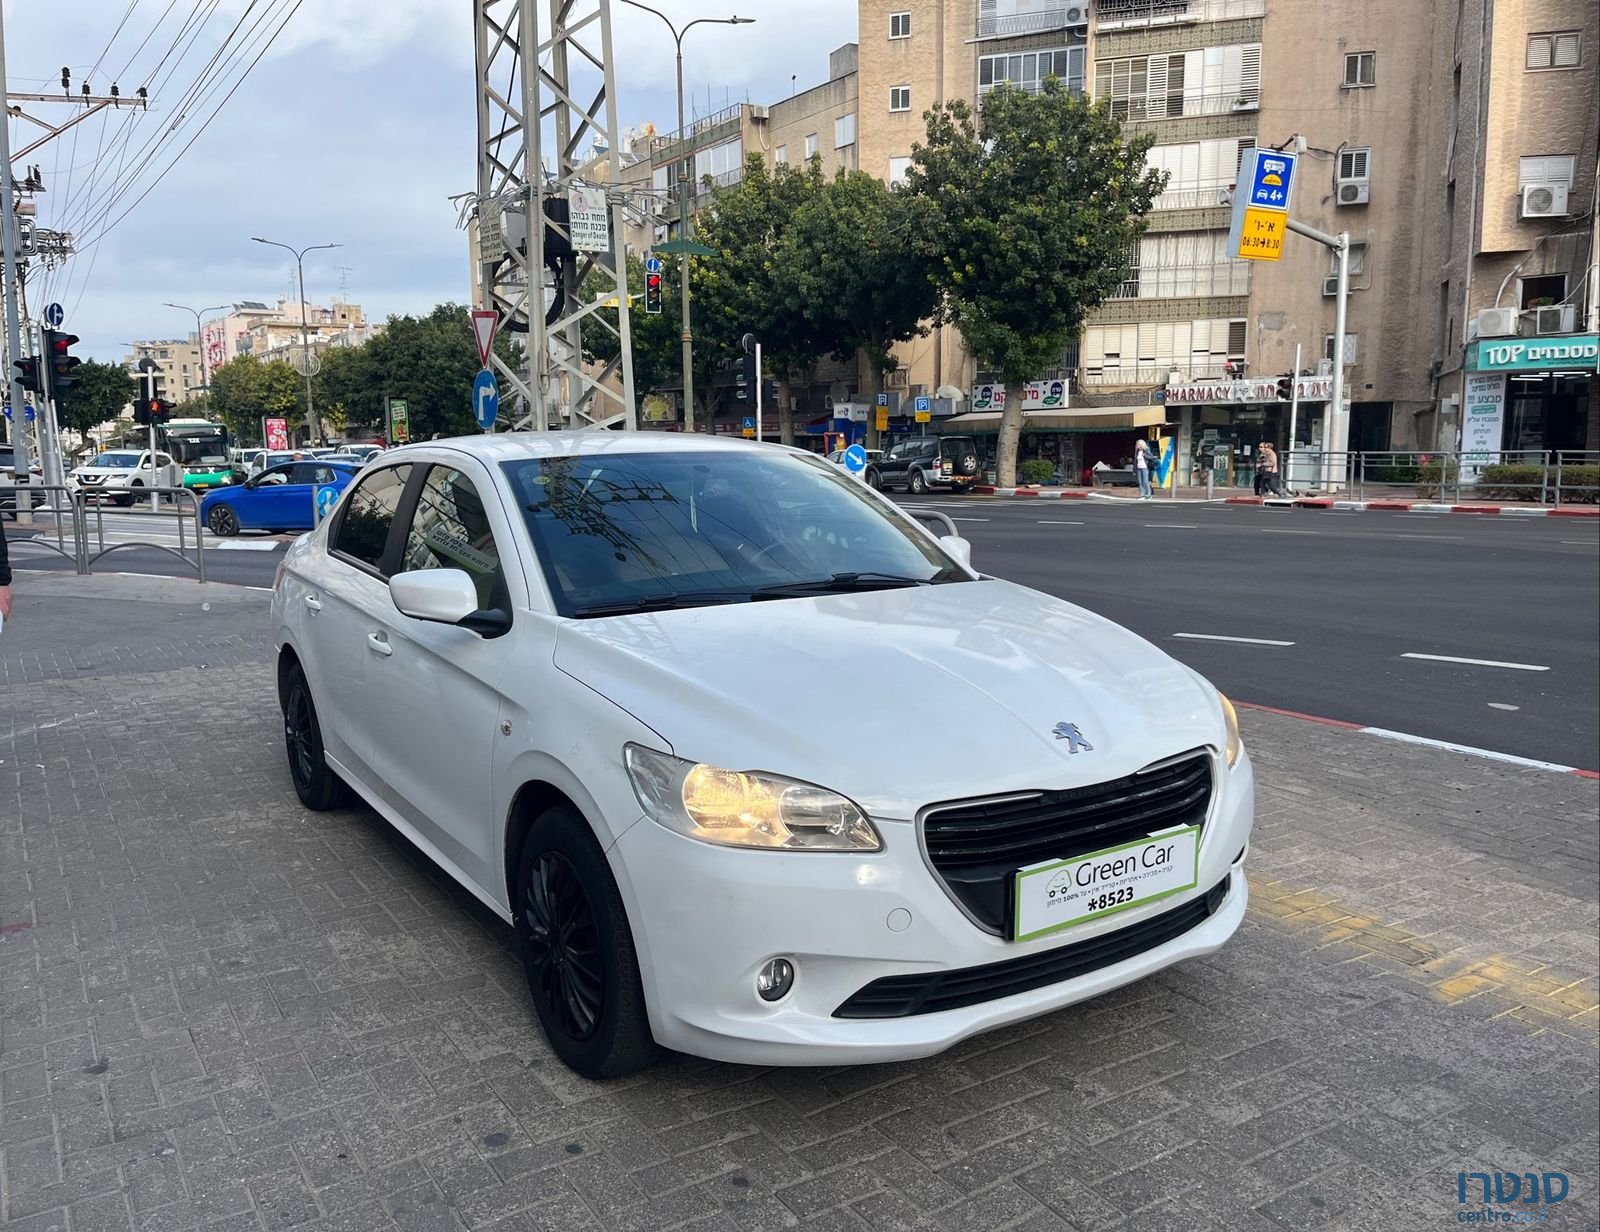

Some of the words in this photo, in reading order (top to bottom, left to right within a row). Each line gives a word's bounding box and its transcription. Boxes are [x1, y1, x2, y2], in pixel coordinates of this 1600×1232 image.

[1270, 190, 1283, 201] 4+
[592, 213, 606, 222] מתח
[590, 223, 606, 232] סכנת
[1486, 344, 1524, 365] TOP
[1166, 386, 1231, 402] PHARMACY
[1478, 395, 1502, 403] מבצע
[1076, 856, 1136, 887] Green
[1142, 844, 1175, 868] Car
